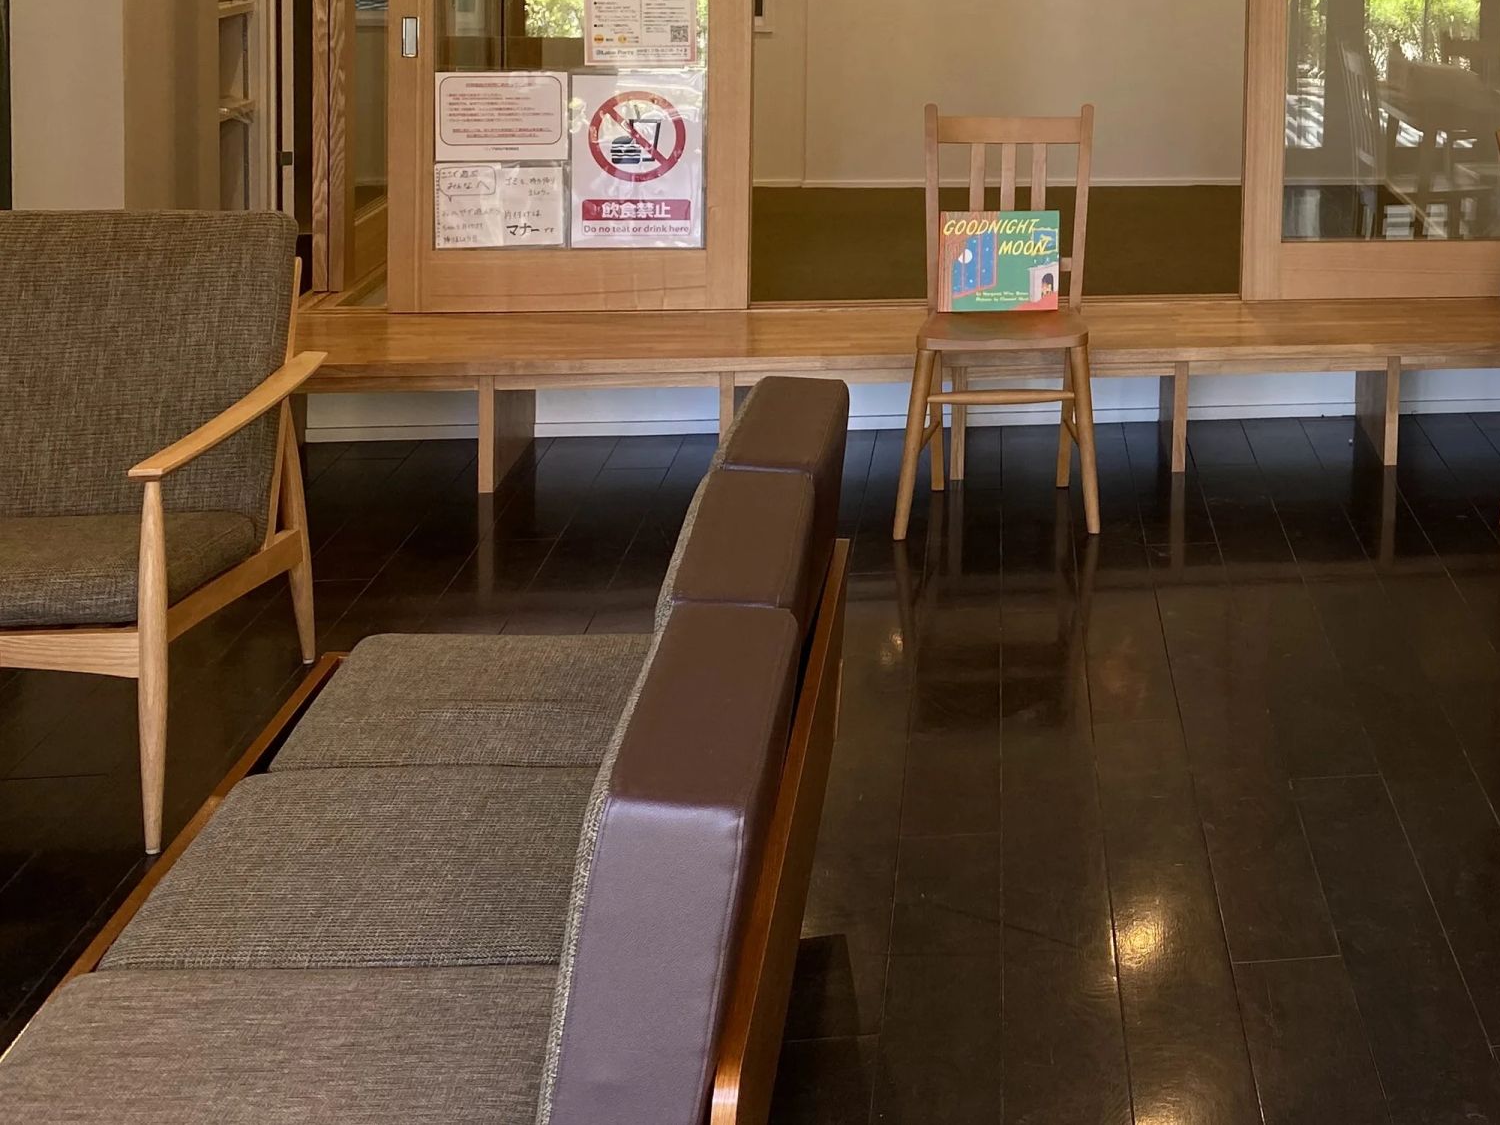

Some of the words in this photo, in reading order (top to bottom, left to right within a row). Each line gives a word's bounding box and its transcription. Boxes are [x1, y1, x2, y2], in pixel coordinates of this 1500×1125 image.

[602, 201, 671, 219] 飲食禁止
[506, 222, 540, 236] マナー
[584, 225, 597, 233] Do
[643, 225, 667, 233] drink
[669, 225, 690, 233] here
[943, 219, 1039, 235] GOODNIGHT
[999, 237, 1049, 256] MOON
